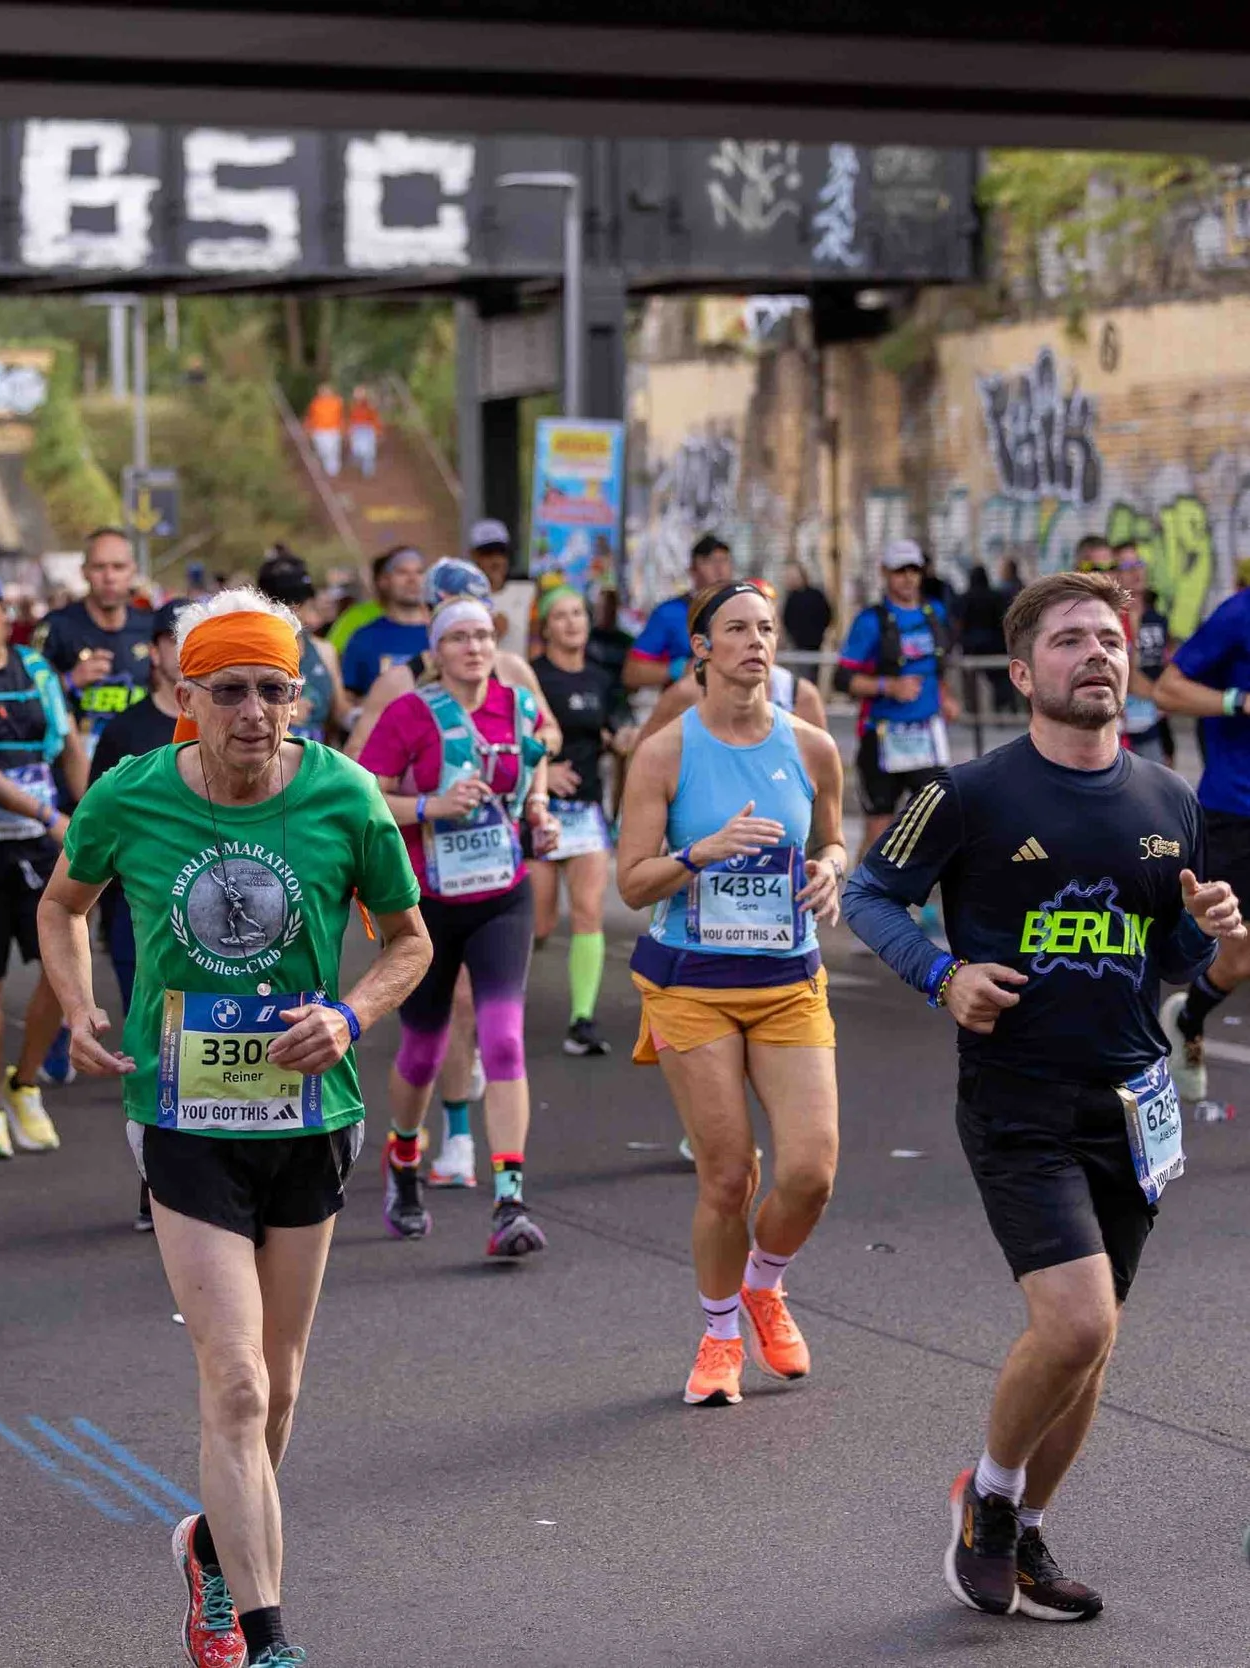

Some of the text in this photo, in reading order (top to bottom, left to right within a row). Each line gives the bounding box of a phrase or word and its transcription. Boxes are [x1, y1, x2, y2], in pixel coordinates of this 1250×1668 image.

[20, 117, 476, 270] BSC
[441, 829, 501, 854] 30610
[171, 841, 304, 903] BERLIN MARATHON
[710, 876, 782, 898] 14384
[702, 929, 769, 941] YOU GOT THIS
[1020, 911, 1154, 957] BERLIN
[187, 947, 282, 976] Jubilee-Club
[223, 1071, 265, 1083] Reiner
[182, 1105, 269, 1121] YOU GOT THIS
